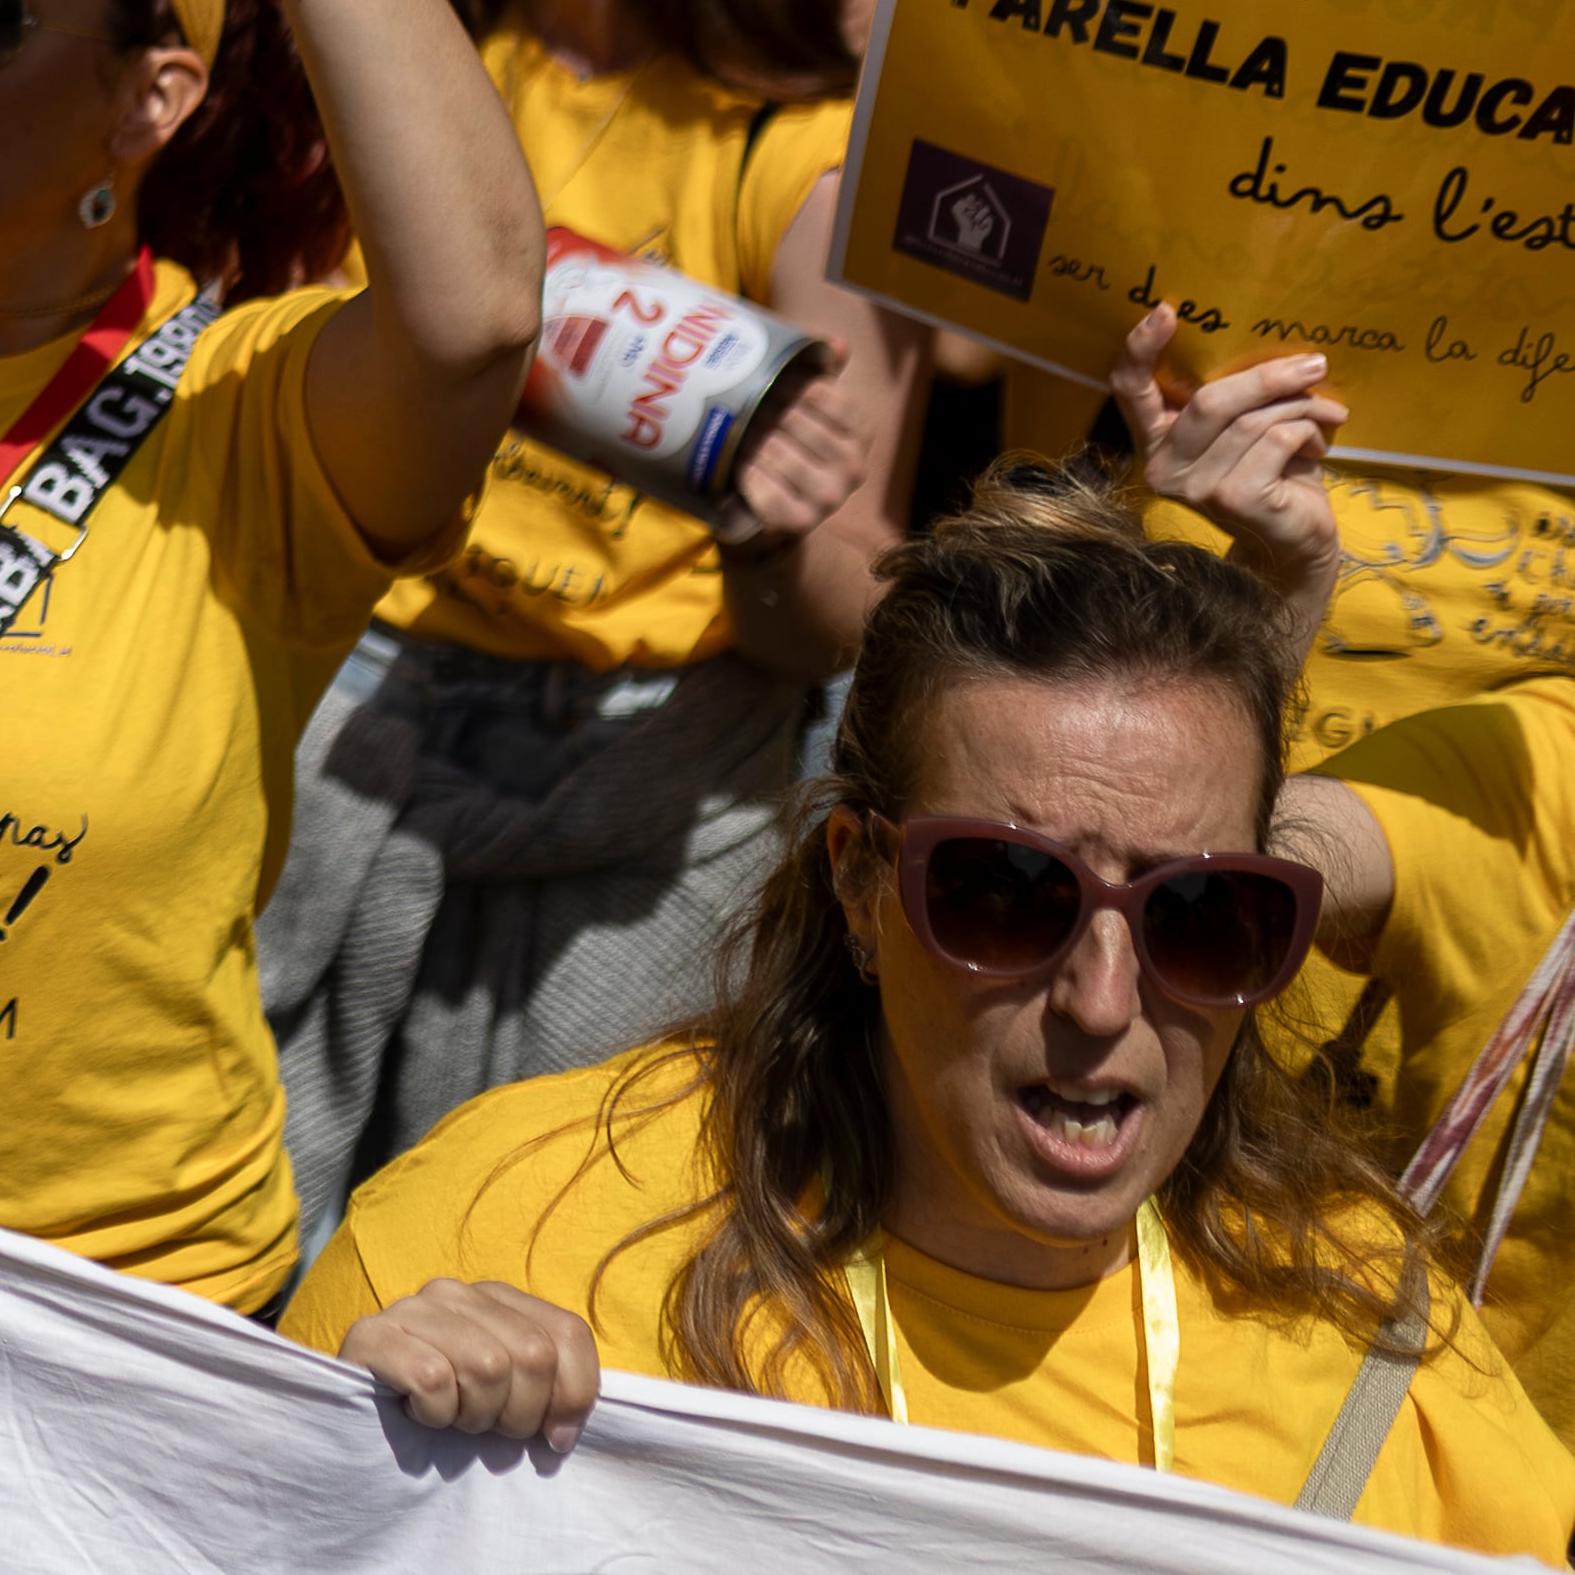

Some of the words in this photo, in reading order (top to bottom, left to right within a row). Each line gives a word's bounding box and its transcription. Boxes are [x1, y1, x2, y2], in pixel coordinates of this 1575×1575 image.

[1228, 135, 1403, 231] dins
[613, 288, 666, 328] 2
[1048, 250, 1112, 293] ser
[1127, 264, 1229, 334] des
[1251, 316, 1406, 354] marca
[1422, 315, 1478, 363] la
